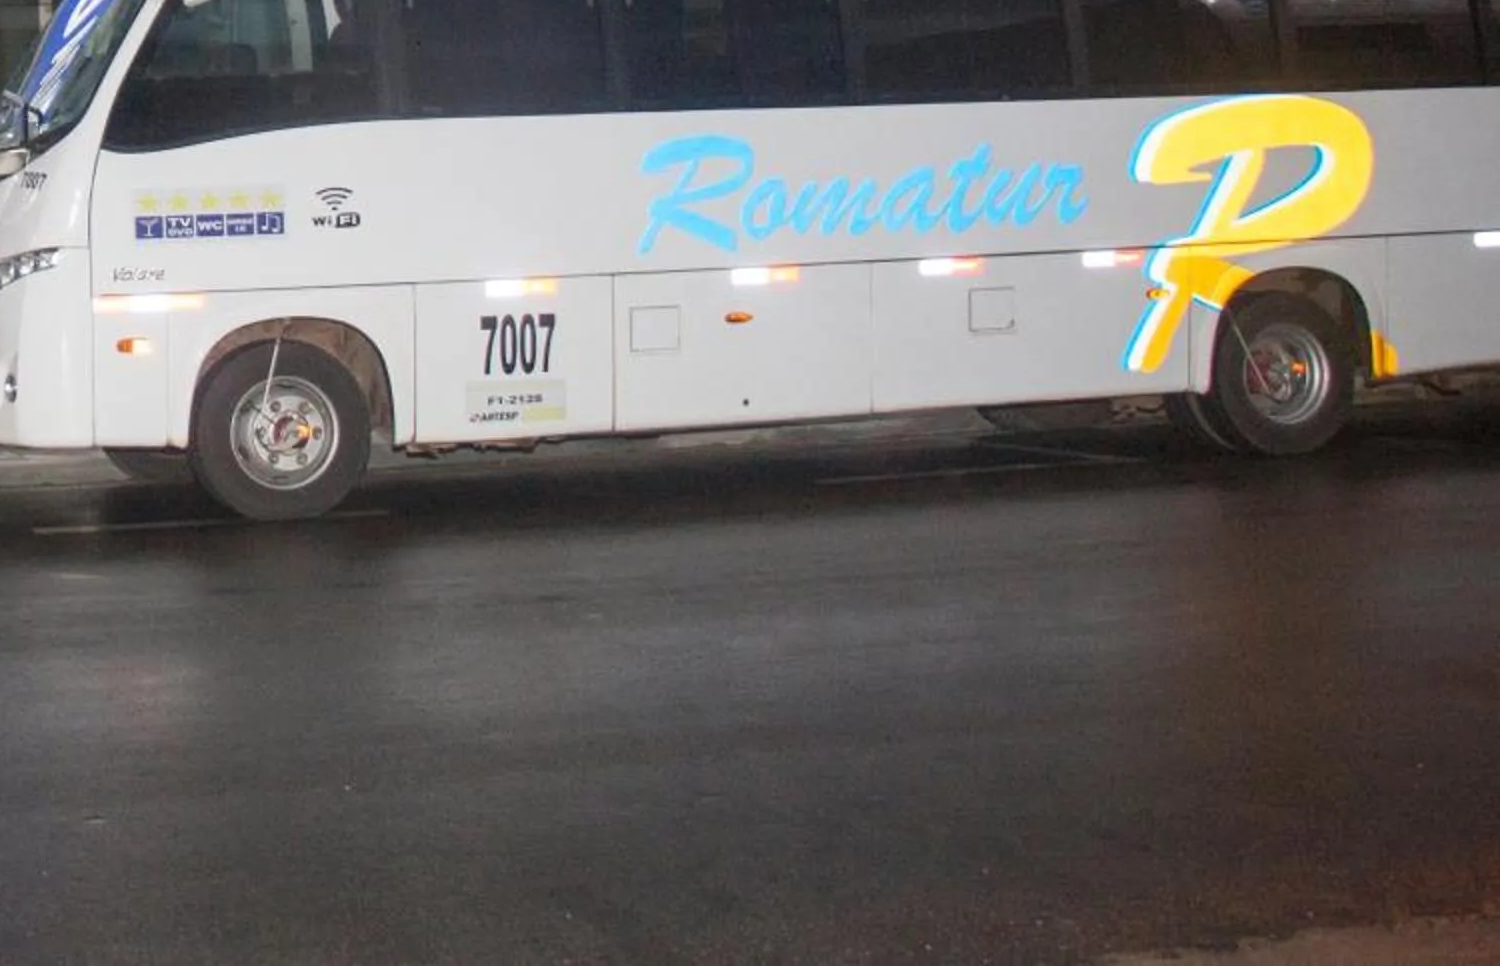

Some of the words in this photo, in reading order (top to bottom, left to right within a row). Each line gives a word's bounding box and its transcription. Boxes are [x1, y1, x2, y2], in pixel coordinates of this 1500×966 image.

[639, 132, 1089, 256] Romatur
[167, 217, 191, 227] TV
[198, 220, 223, 231] WC
[479, 313, 556, 375] 7007
